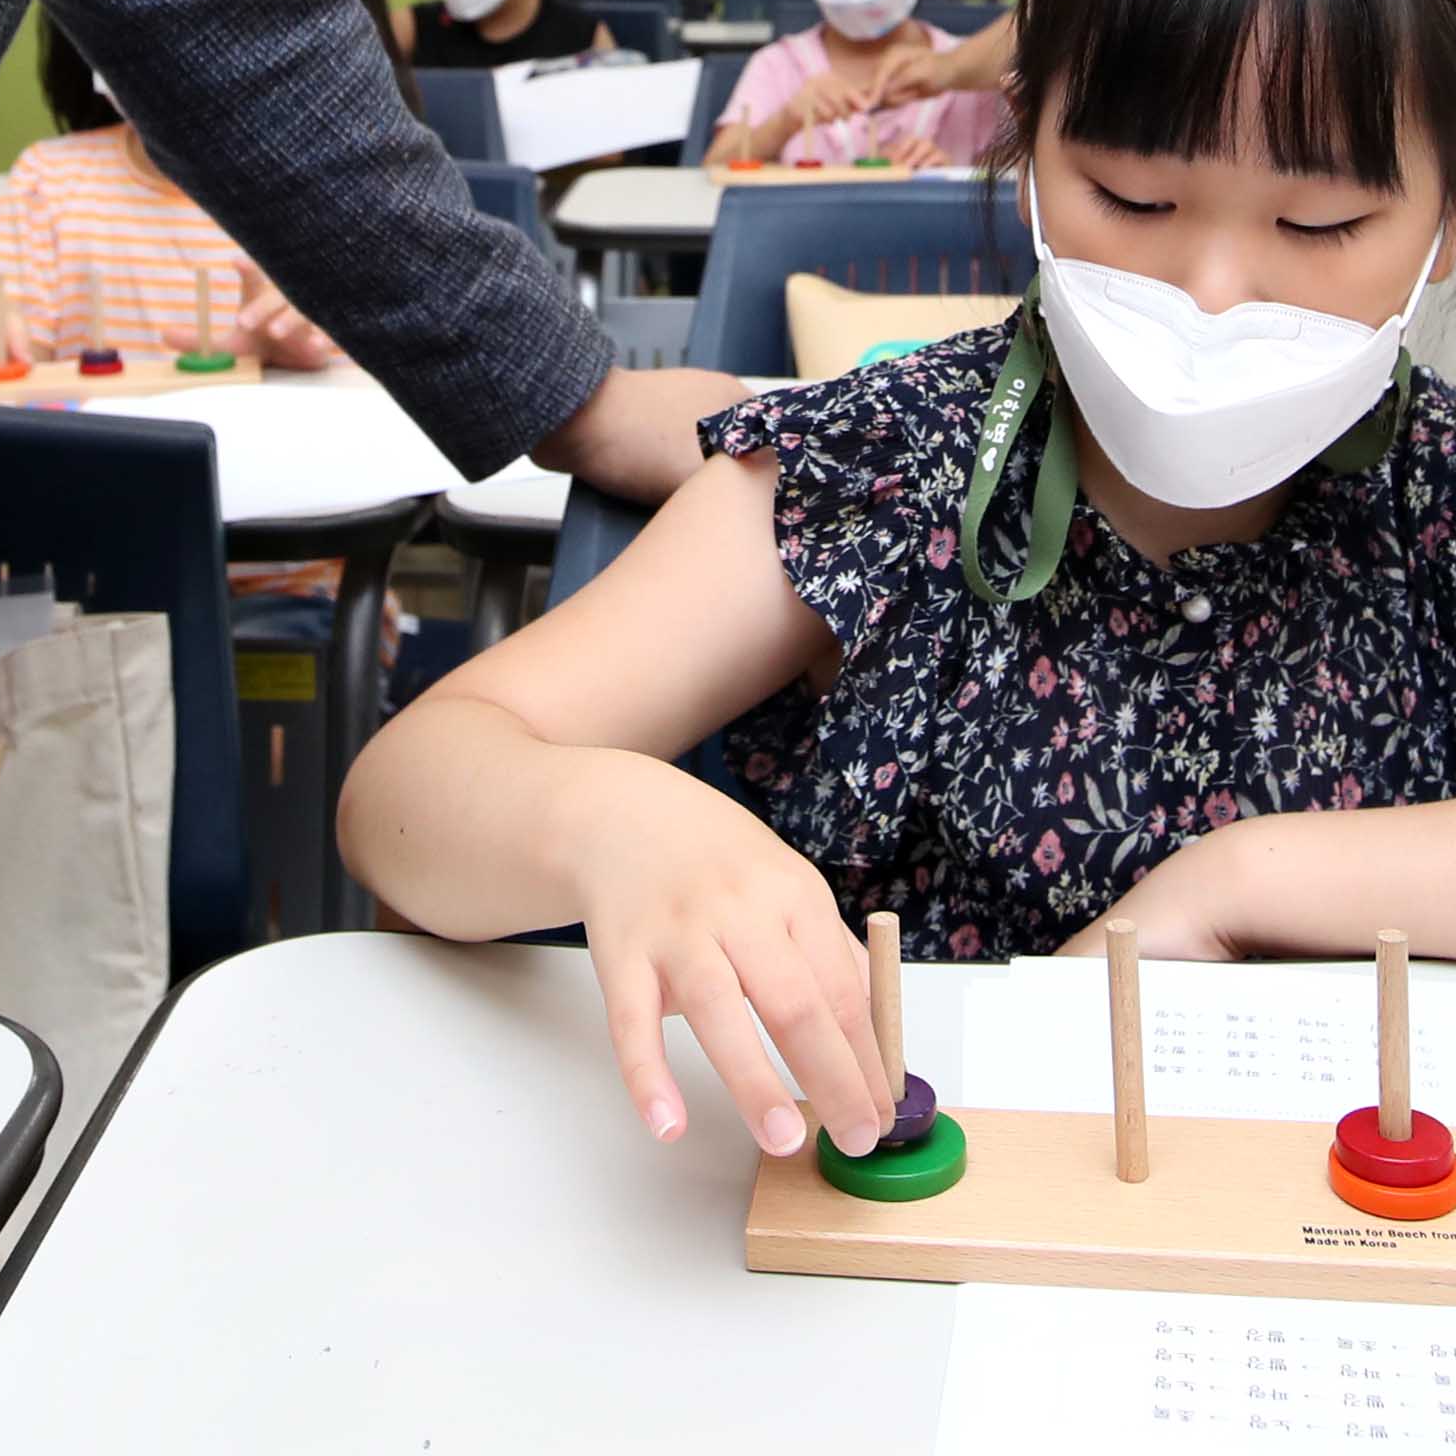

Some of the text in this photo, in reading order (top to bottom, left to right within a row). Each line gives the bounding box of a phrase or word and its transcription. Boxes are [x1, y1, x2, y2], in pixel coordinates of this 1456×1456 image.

[1302, 1225, 1362, 1237] Materials
[1365, 1228, 1384, 1237] for
[1388, 1229, 1428, 1240] Beech
[1304, 1236, 1398, 1249] Made in Korea
